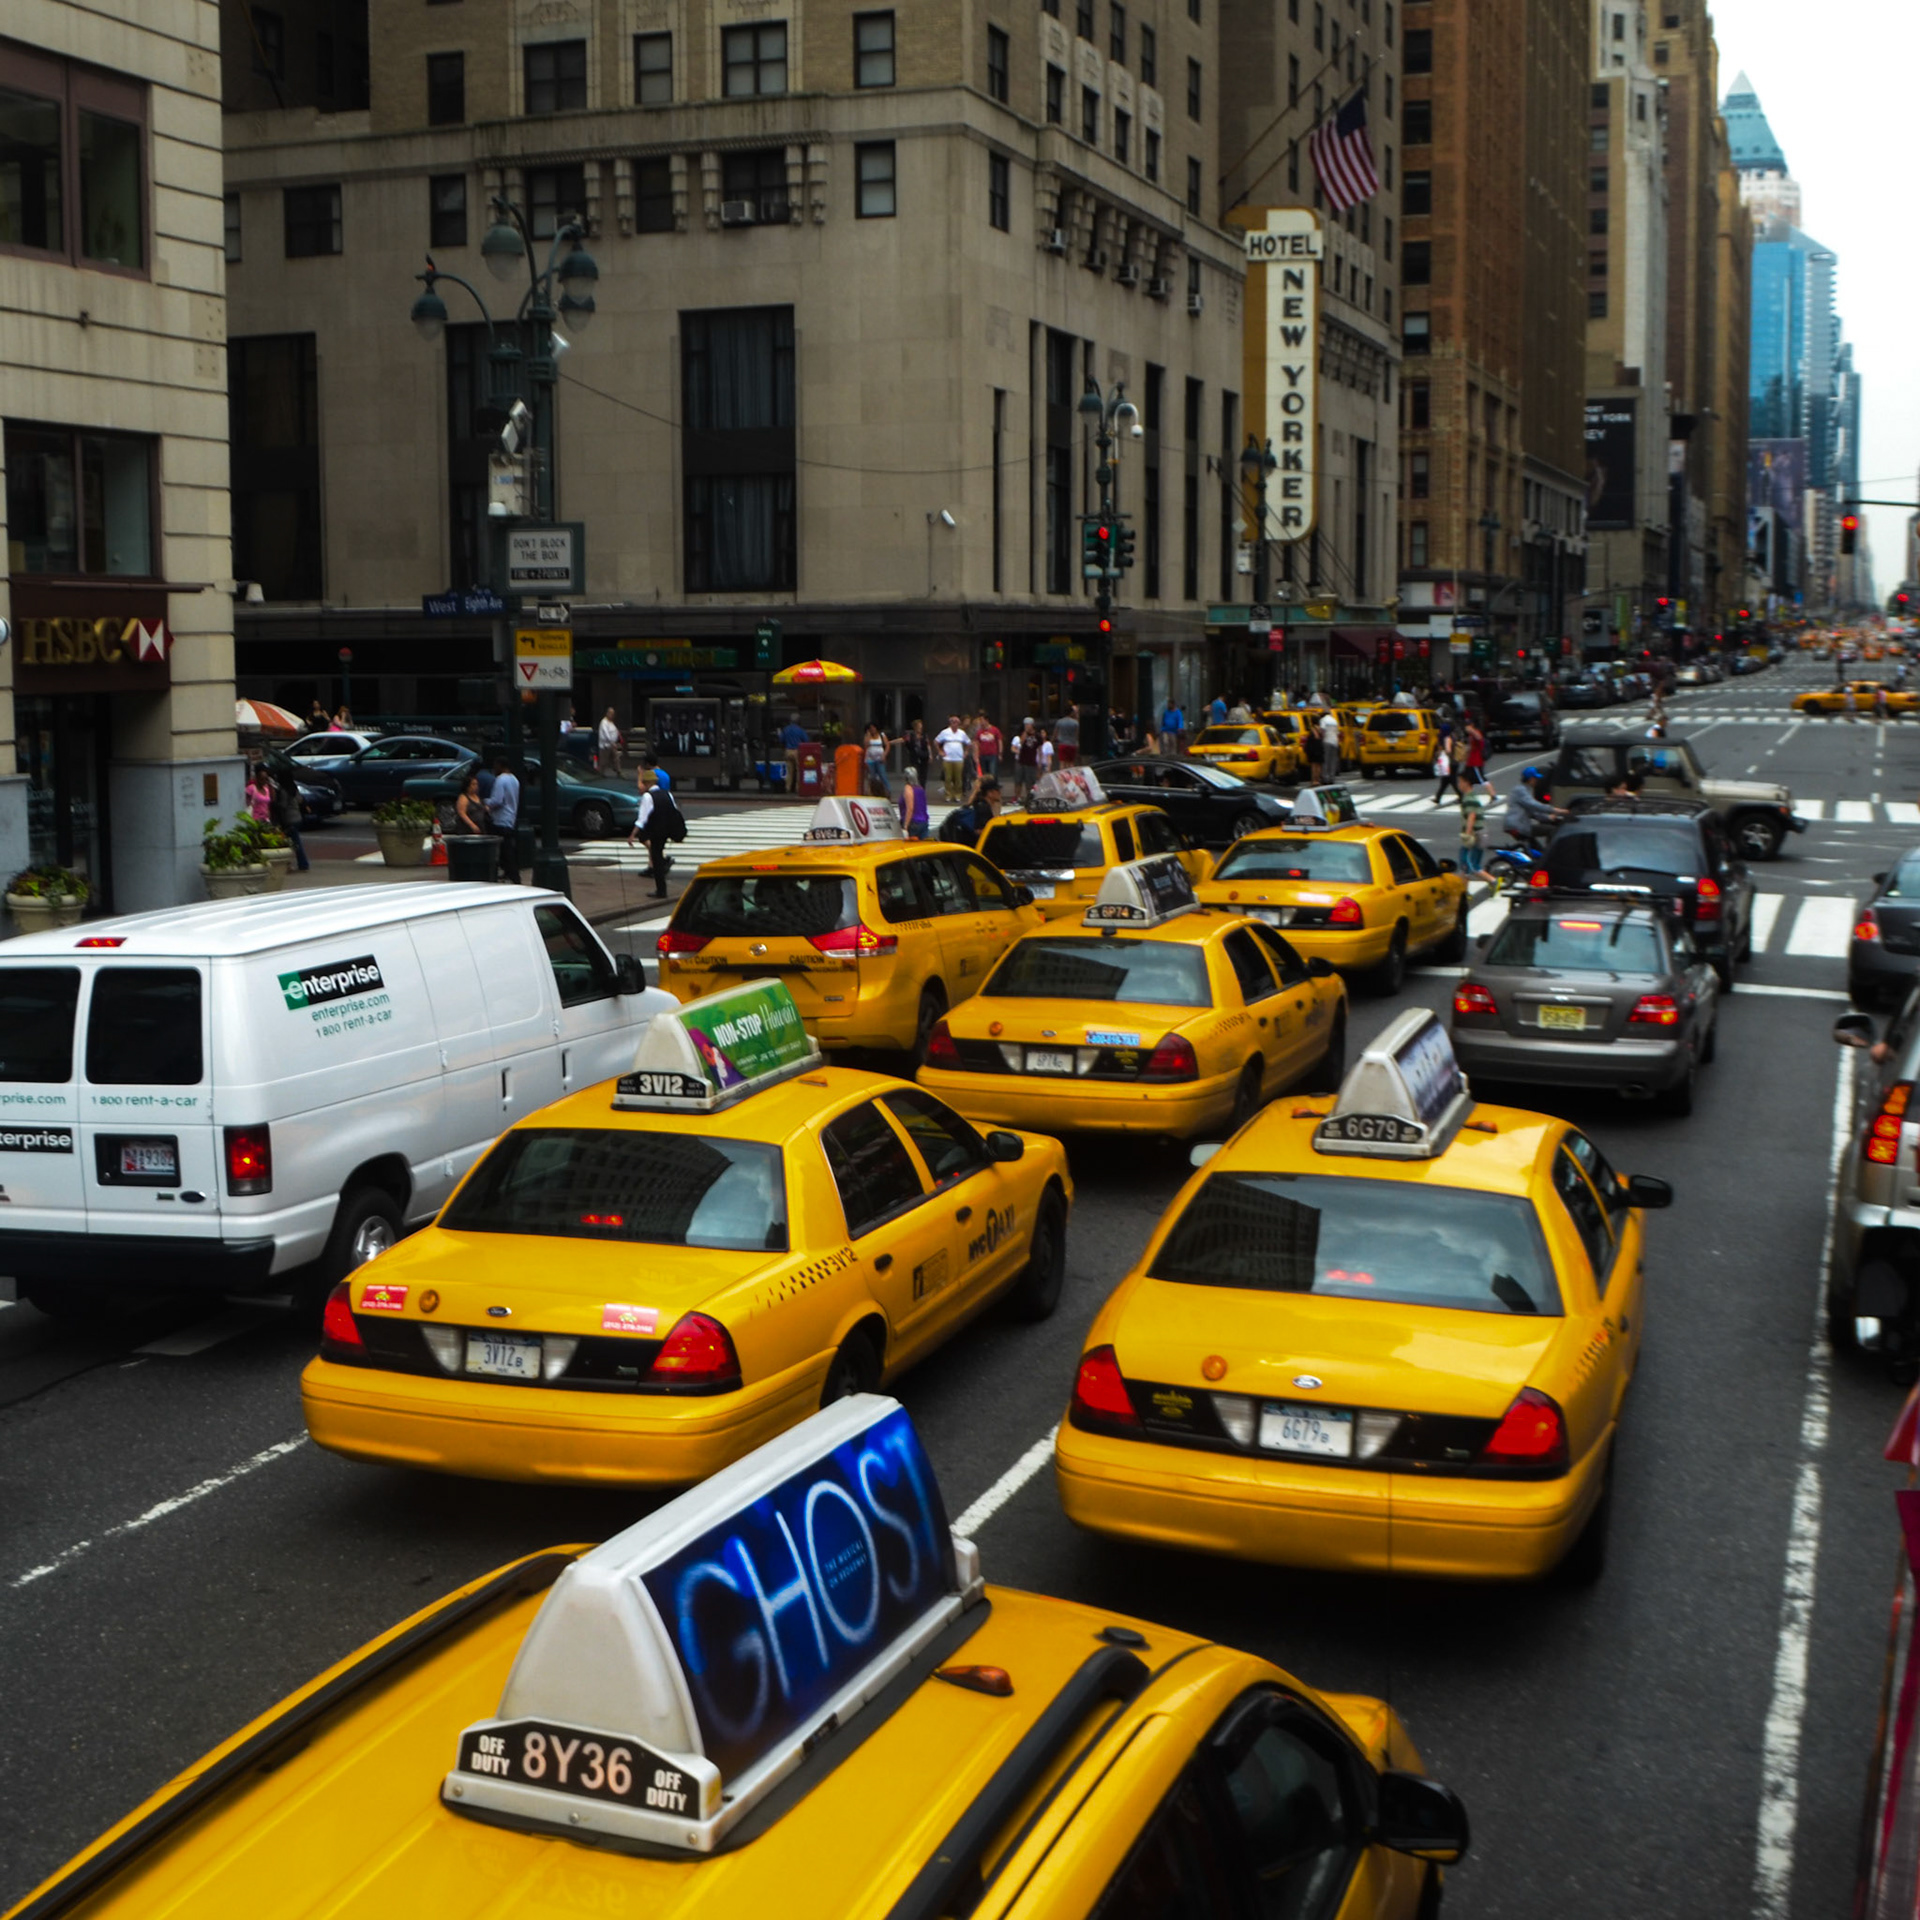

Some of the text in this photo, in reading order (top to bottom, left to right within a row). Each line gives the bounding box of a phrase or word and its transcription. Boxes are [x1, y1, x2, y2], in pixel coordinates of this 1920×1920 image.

[1250, 235, 1318, 256] HOTEL
[1281, 269, 1306, 527] NEW YORKER
[513, 538, 566, 548] DON'T BLOCK
[521, 551, 559, 560] THE BOX
[429, 600, 457, 614] West
[465, 596, 503, 613] Eighth Ave
[20, 617, 123, 664] HSBC
[695, 955, 728, 966] CAUTION
[789, 954, 825, 966] CAUTION
[283, 964, 380, 999] enterprise
[312, 993, 390, 1021] enterprise.com
[323, 1022, 342, 1037] 800
[343, 1009, 393, 1031] rent-a-car
[712, 1012, 762, 1049] NON-STOP
[639, 1074, 683, 1095] 3V12
[0, 1092, 67, 1106] prise.com
[100, 1096, 122, 1105] 800
[125, 1094, 198, 1107] rent-a-car
[1346, 1117, 1398, 1140] 6G79
[677, 1421, 941, 1742] GHOST
[479, 1735, 505, 1754] OFF
[471, 1752, 510, 1776] DUTY
[522, 1731, 632, 1795] 8Y36
[654, 1769, 682, 1790] OFF
[646, 1787, 687, 1811] DUTY
